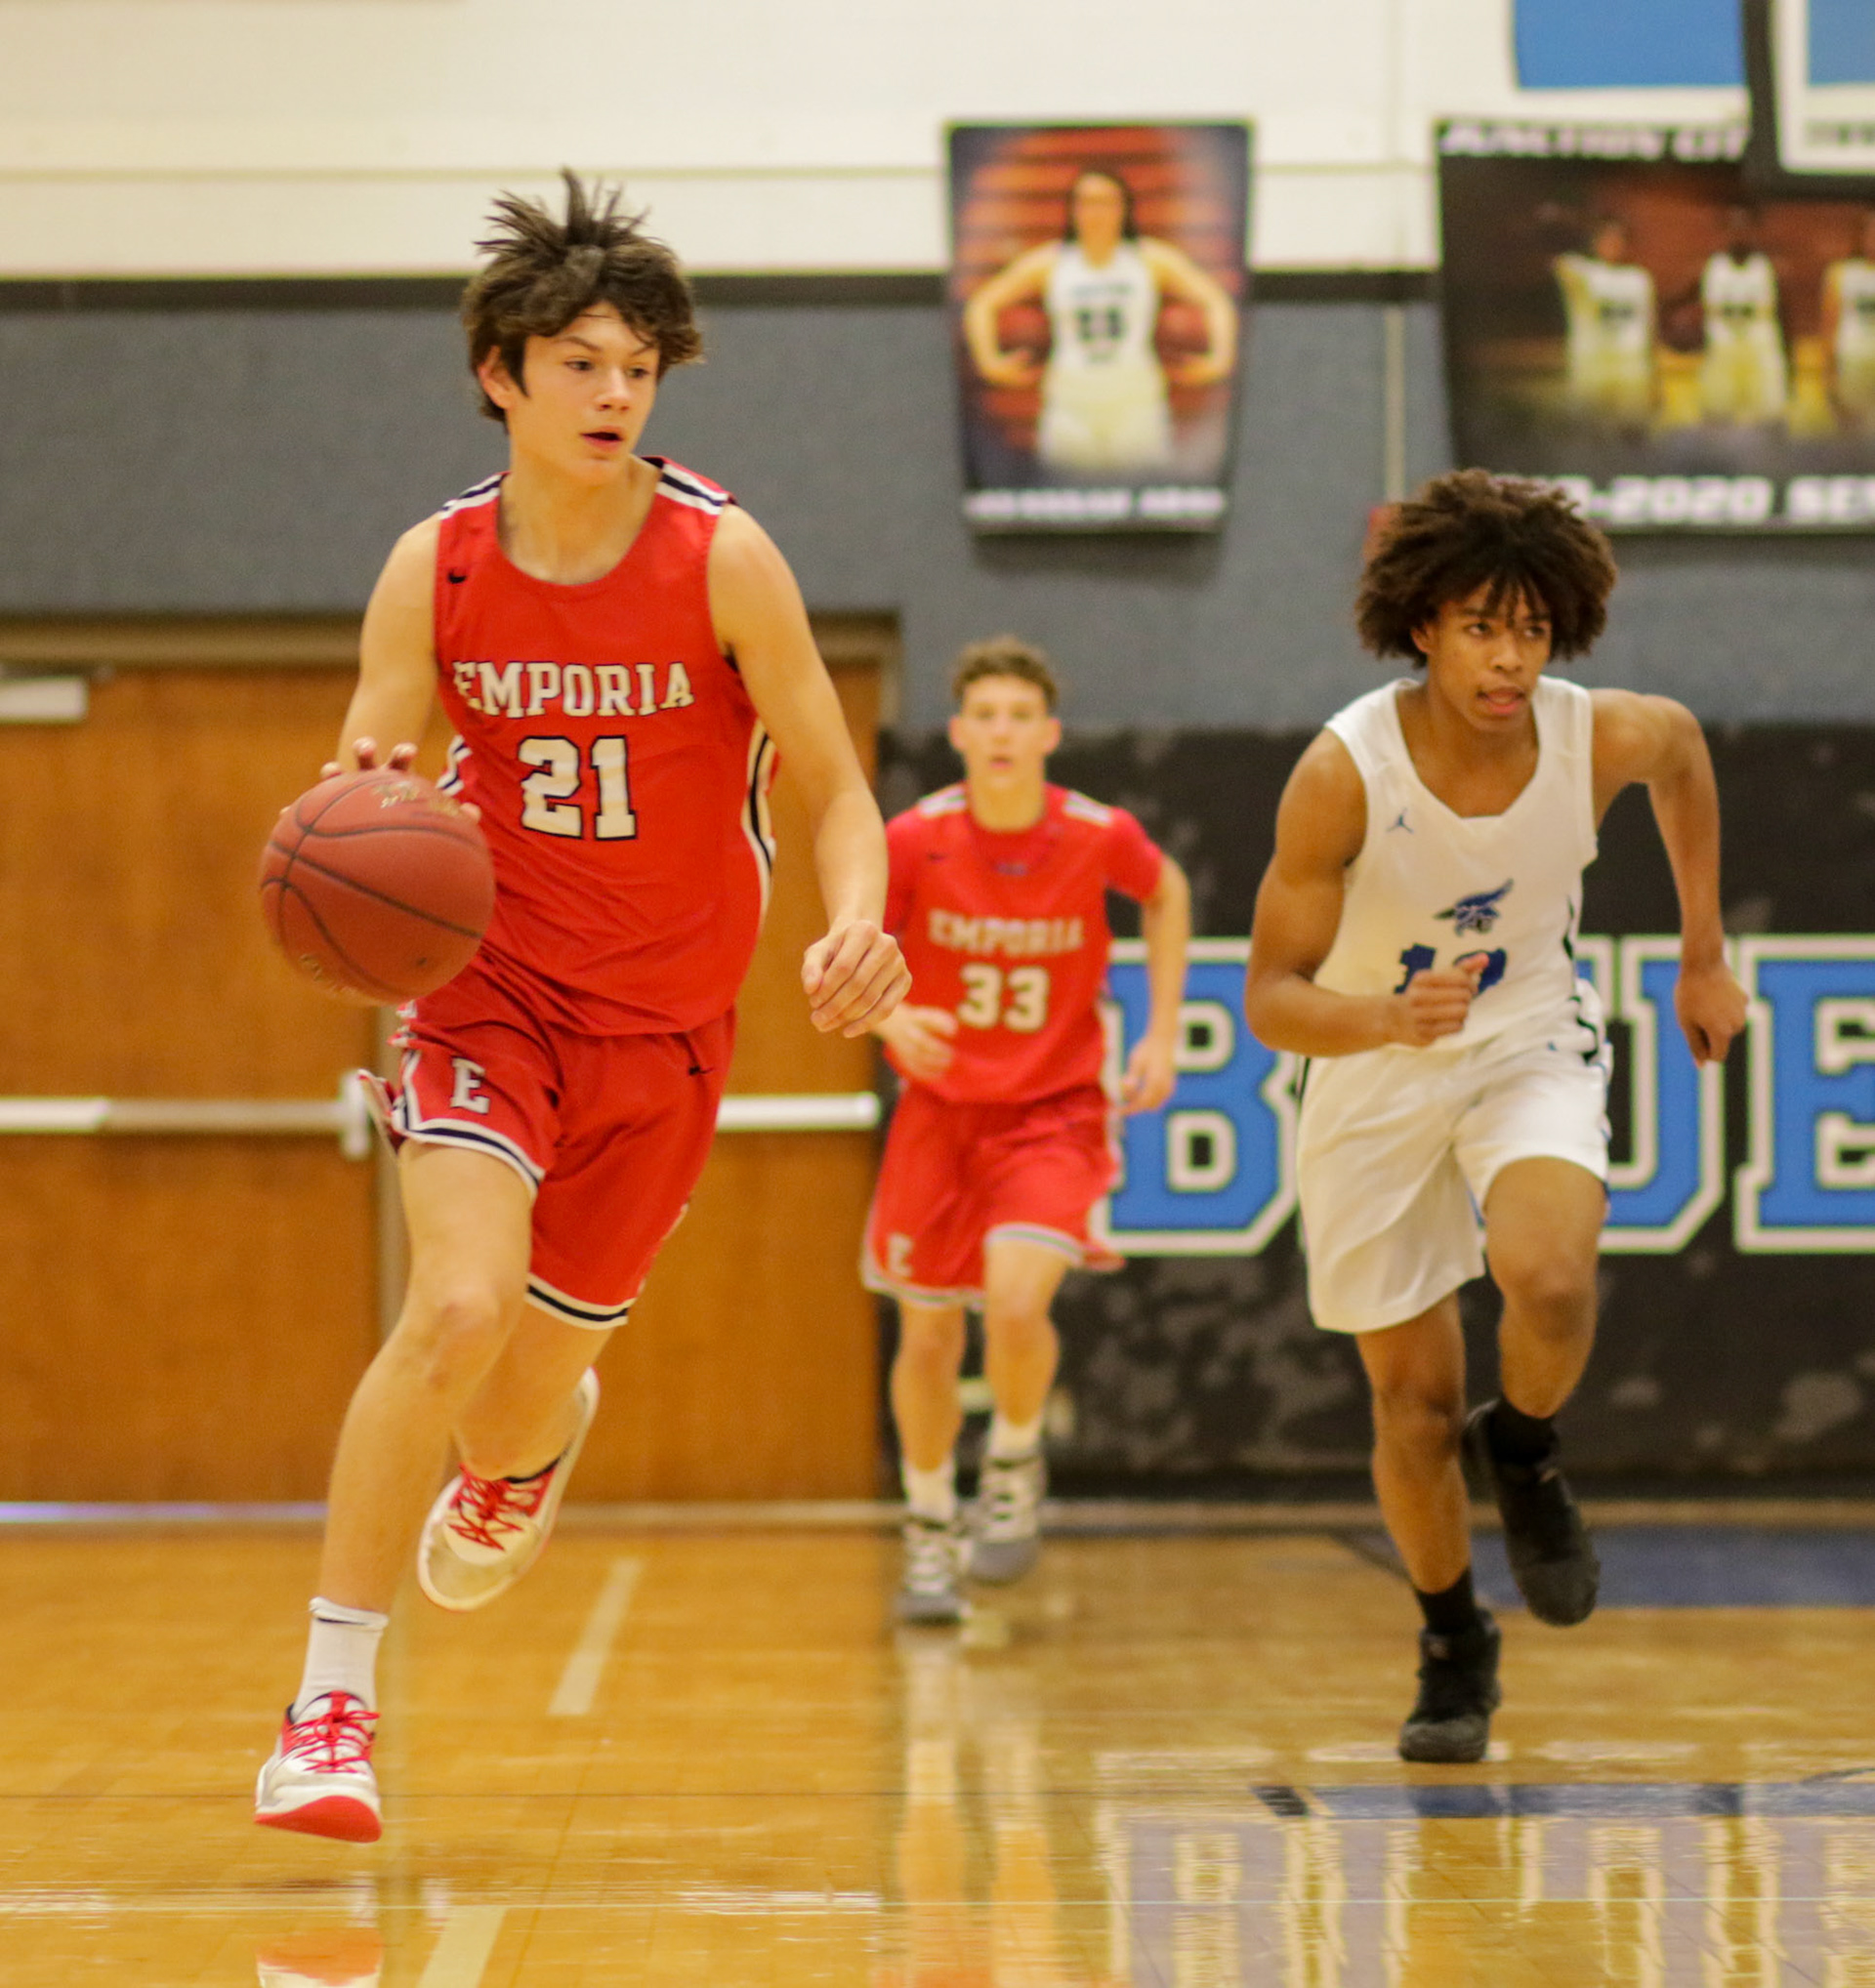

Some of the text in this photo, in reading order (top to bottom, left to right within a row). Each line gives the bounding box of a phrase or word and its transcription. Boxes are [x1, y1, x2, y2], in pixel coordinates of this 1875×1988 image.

[452, 661, 694, 718] EMPORIA
[518, 735, 638, 841] 21
[957, 962, 1051, 1033] 33
[450, 1056, 490, 1115] E
[1086, 934, 1875, 1255] BUE
